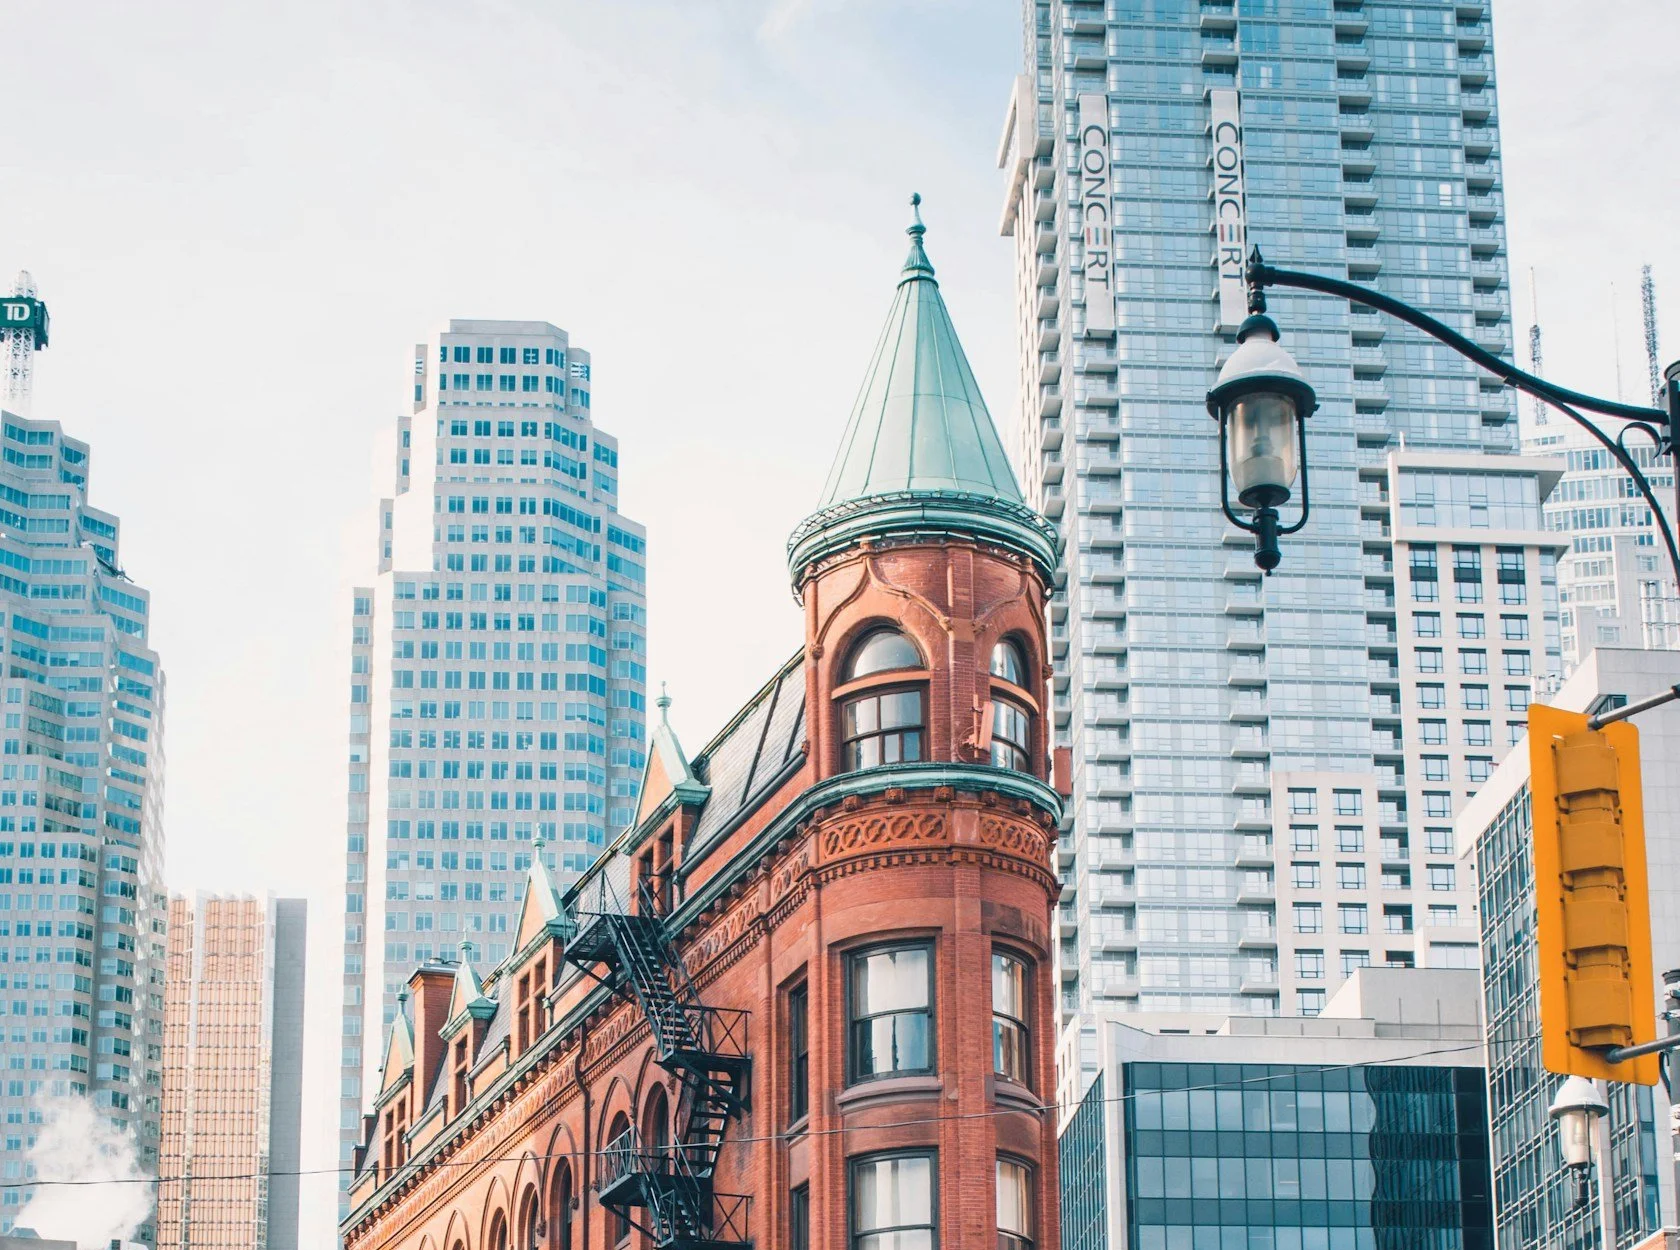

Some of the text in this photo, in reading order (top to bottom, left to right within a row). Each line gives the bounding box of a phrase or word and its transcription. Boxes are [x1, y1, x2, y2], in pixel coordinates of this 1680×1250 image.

[1083, 125, 1109, 290] CONCERT
[1215, 122, 1243, 286] CONCERT
[2, 303, 31, 321] TD
